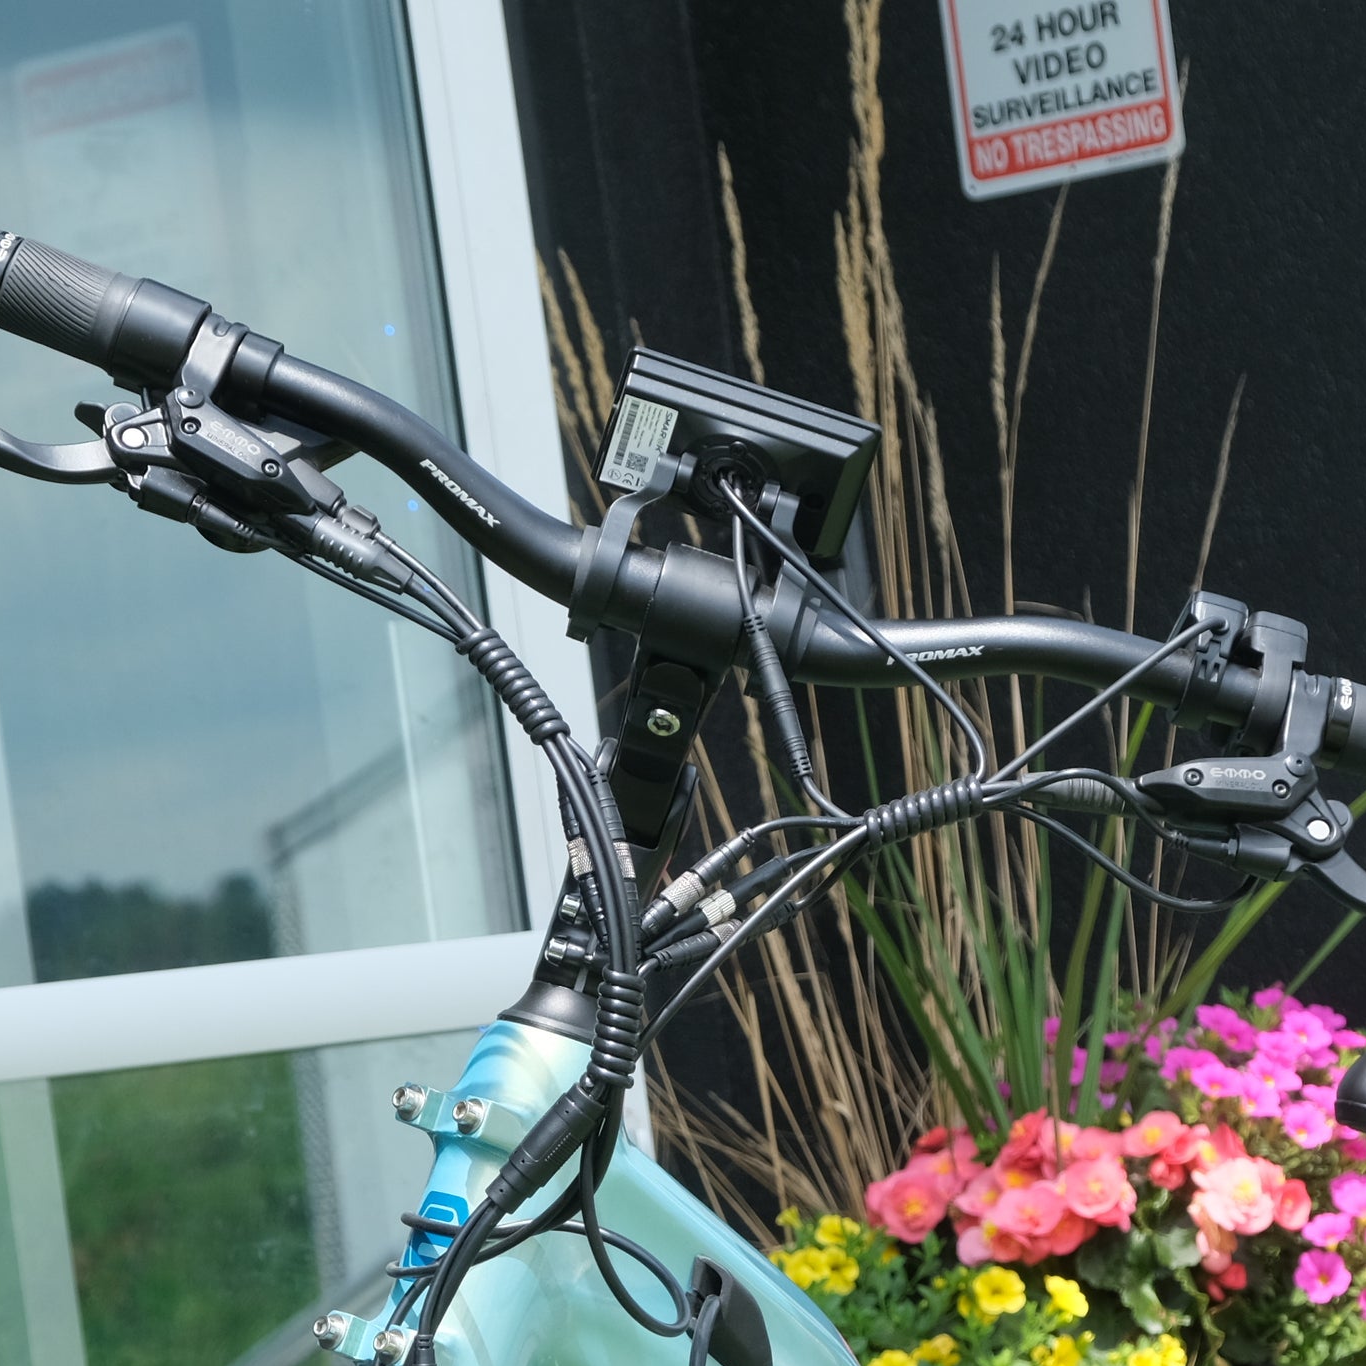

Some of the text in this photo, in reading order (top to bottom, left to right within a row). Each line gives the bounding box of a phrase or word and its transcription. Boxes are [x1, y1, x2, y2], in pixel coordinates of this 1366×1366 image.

[990, 1, 1121, 52] 24 HOUR
[1013, 41, 1107, 85] VIDEO
[972, 67, 1158, 130] SURVEILLANCE
[973, 104, 1167, 173] NO TRESPASSING
[419, 458, 501, 528] PROMAX
[1209, 767, 1267, 780] EMMO
